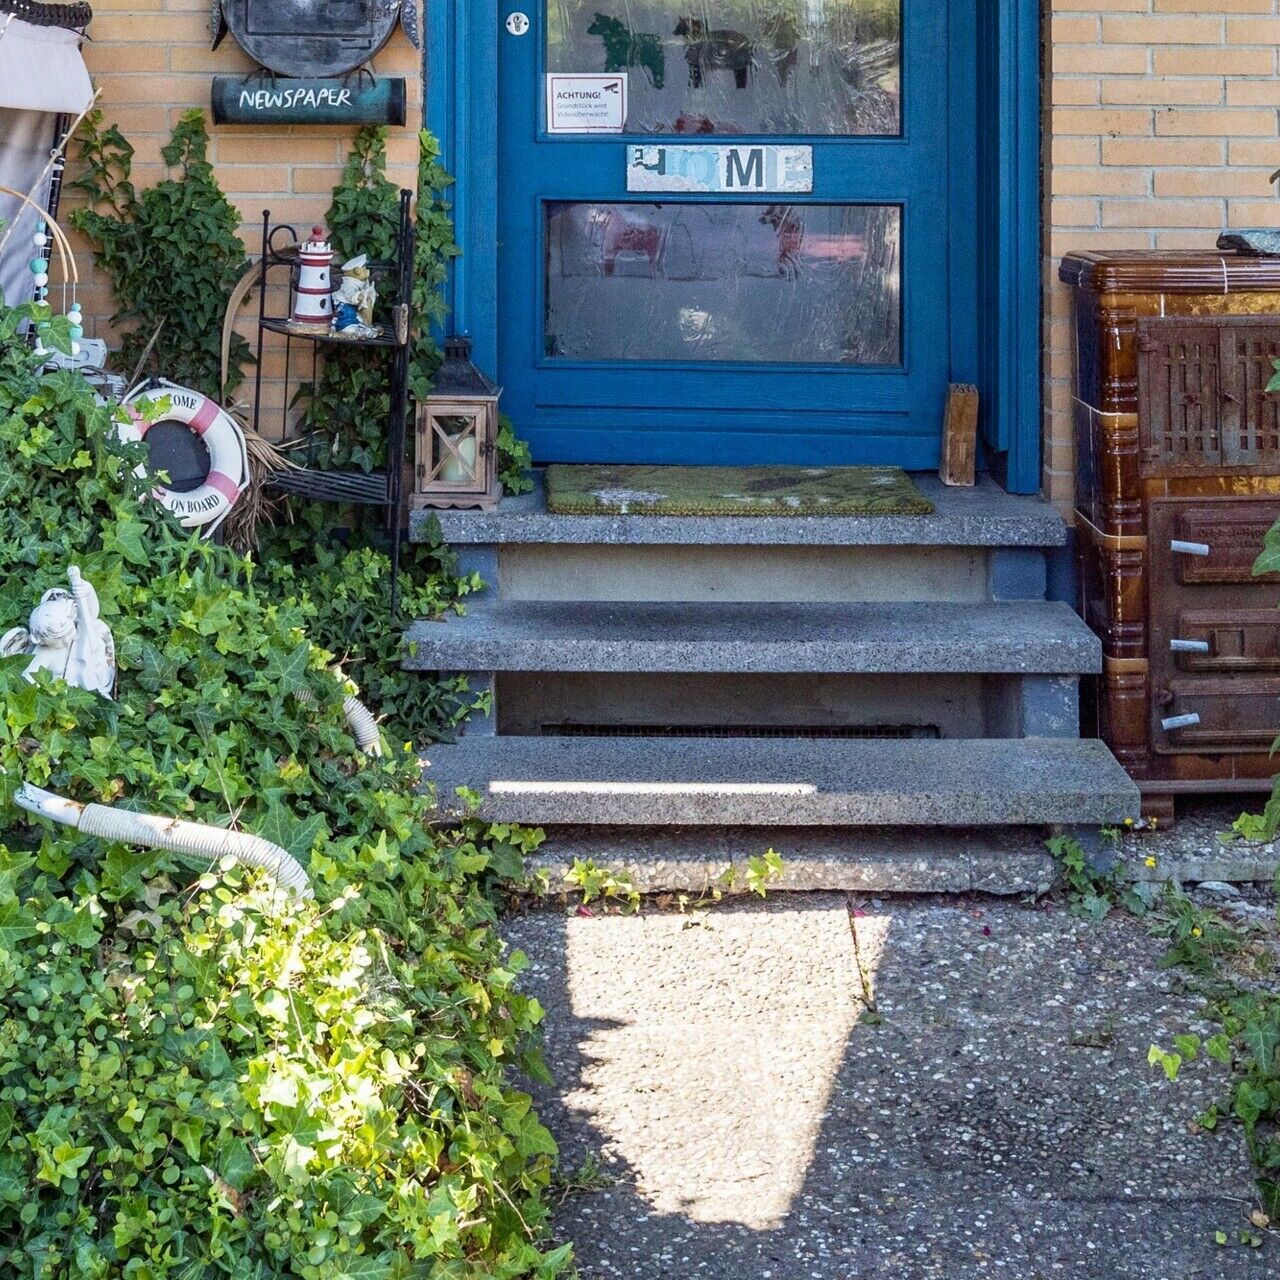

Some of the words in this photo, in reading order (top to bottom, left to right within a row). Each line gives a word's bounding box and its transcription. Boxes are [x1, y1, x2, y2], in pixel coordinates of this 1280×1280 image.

[239, 88, 353, 110] NEWSPAPER
[556, 91, 602, 100] ACHTUNG!
[170, 499, 185, 513] ON
[186, 494, 220, 514] BOARD
